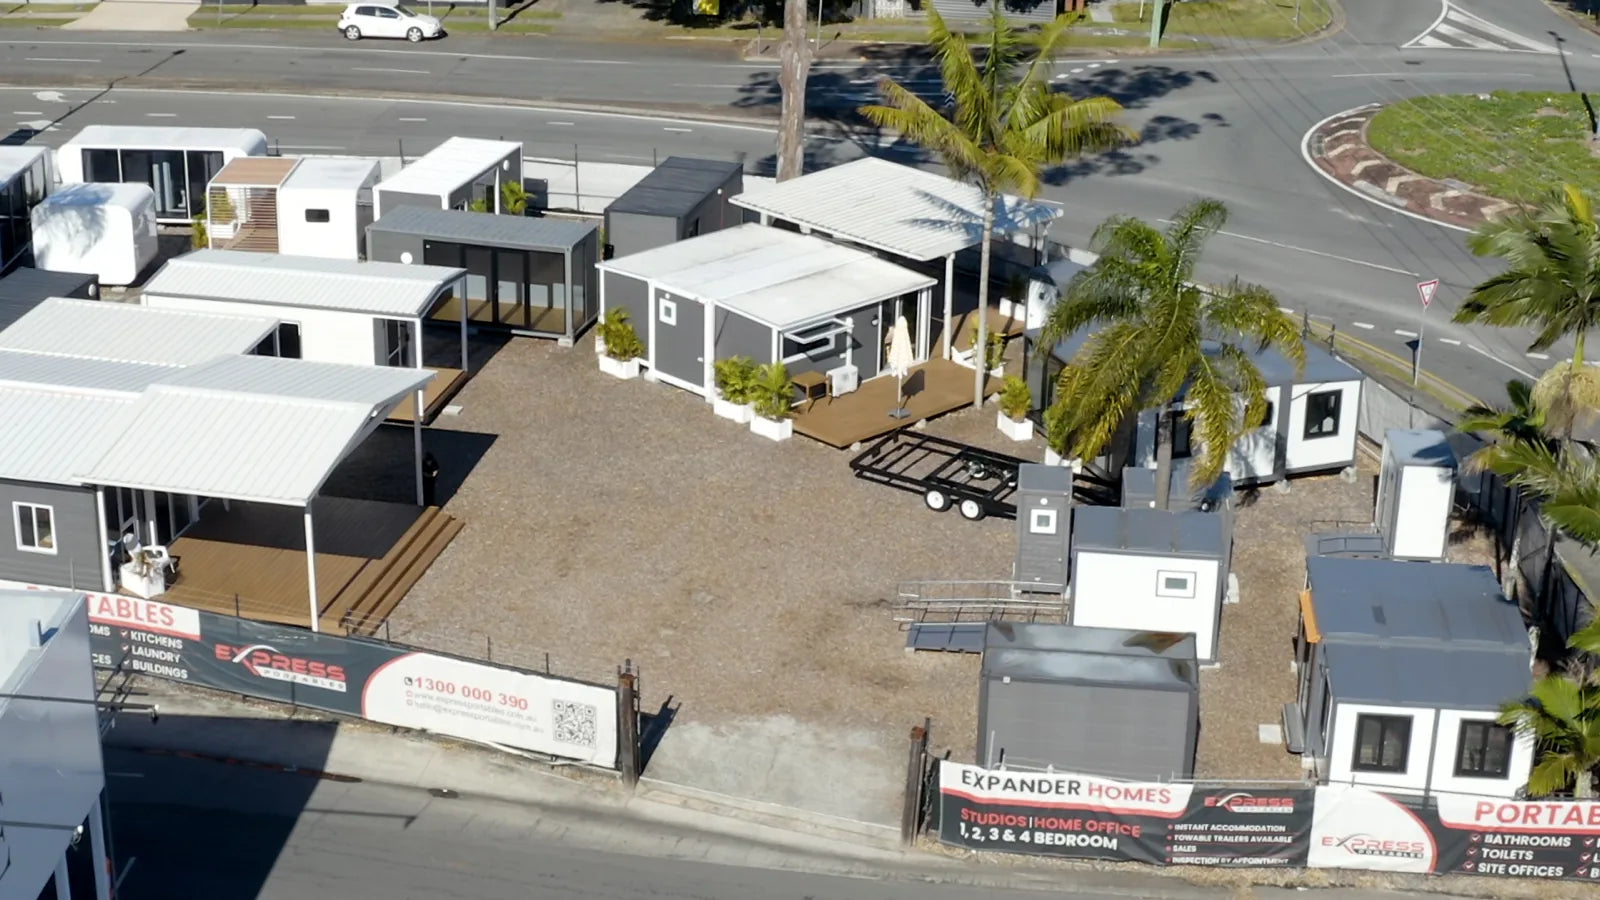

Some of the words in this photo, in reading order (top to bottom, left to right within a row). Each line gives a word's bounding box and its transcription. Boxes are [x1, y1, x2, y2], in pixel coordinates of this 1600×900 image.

[131, 630, 183, 650] KITCHENS
[132, 645, 181, 664] LAUNDRY
[215, 644, 346, 681] EXPRESS
[132, 659, 188, 679] BUILDINGS
[415, 677, 455, 695] 1300
[461, 685, 492, 702] 000
[498, 692, 528, 710] 390
[961, 770, 1081, 795] EXPANDER
[1088, 782, 1171, 804] HOMES
[1204, 793, 1295, 812] EXPRESS
[961, 808, 1027, 828] STUDIOS
[1034, 819, 1082, 831] HOME
[1085, 820, 1141, 838] OFFICE
[1174, 824, 1208, 832] INSTANT
[1210, 824, 1286, 833] ACCOMMODATION
[989, 829, 999, 841] 3
[1002, 829, 1016, 843] &
[1019, 830, 1031, 844] 4
[1034, 831, 1118, 850] BEDROOM
[1173, 834, 1211, 842] TOWABLE
[1213, 834, 1249, 843] TRAILERS
[1250, 835, 1293, 844] AVAILABLE
[1321, 833, 1425, 855] EXPRESS
[1484, 833, 1572, 848] BATHROOMS
[1172, 845, 1197, 853] SALES
[1481, 847, 1534, 861] TOILETS
[1172, 856, 1220, 865] INSPECTION
[1477, 862, 1506, 874] SITE
[1508, 864, 1564, 877] OFFICES
